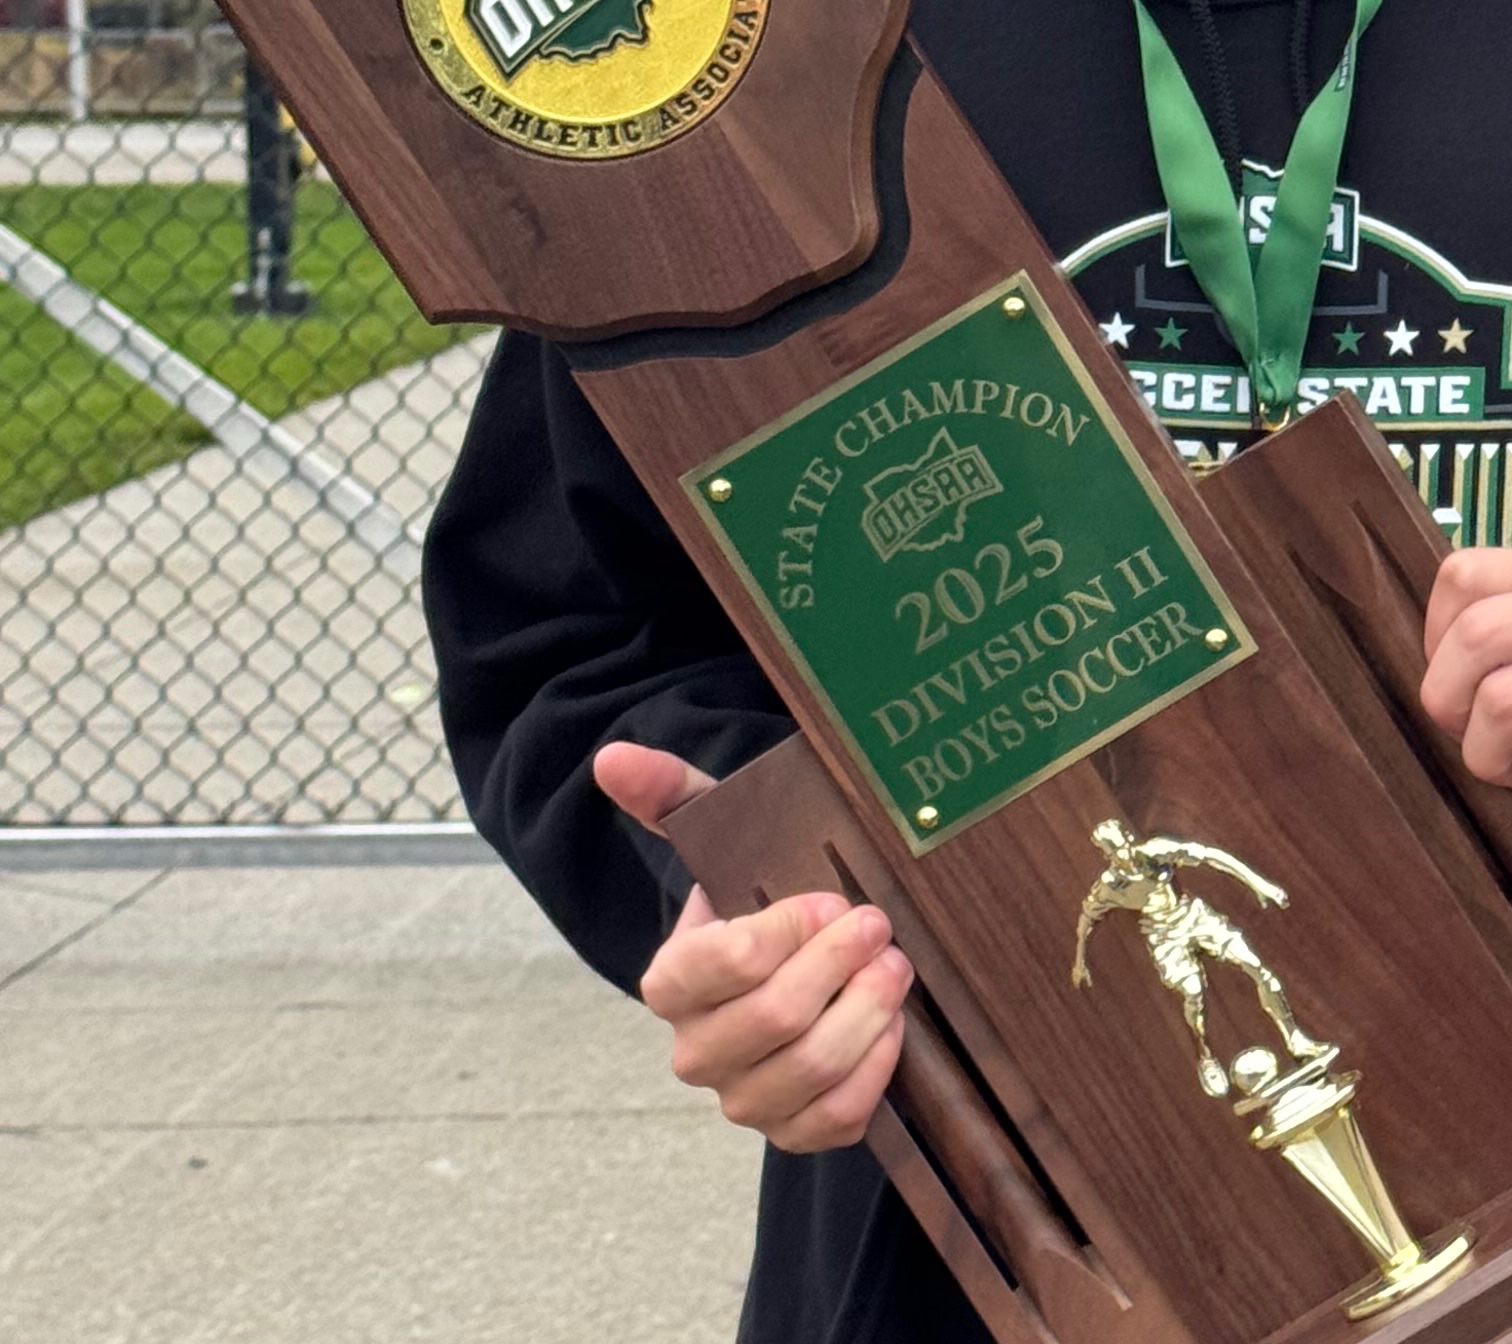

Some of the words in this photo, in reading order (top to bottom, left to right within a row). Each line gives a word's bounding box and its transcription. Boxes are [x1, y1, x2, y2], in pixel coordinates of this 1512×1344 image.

[463, 83, 642, 149] ATHLETIC
[779, 455, 843, 611] STATE
[833, 378, 1090, 459] CHAMPION
[871, 457, 992, 549] OHSAA
[871, 575, 1116, 747] DIVISION
[1113, 544, 1169, 601] II
[895, 515, 1064, 656] 2025
[900, 702, 1026, 803] BOYS
[1020, 600, 1204, 732] SOCCER
